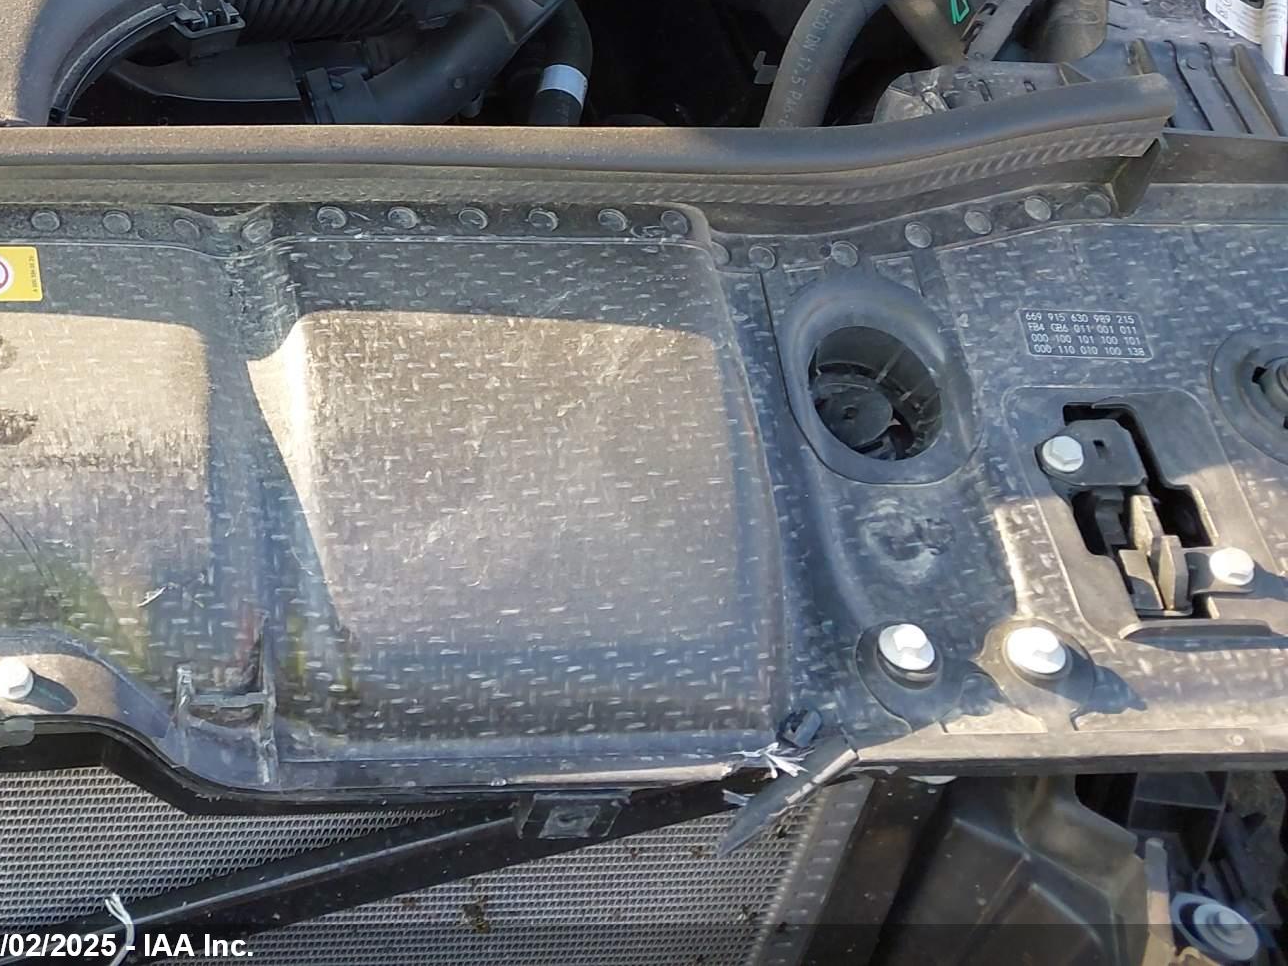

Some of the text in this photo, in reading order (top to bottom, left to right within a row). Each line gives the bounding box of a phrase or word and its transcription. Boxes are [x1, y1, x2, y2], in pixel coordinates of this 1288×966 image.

[811, 5, 834, 32] ECO
[801, 32, 821, 52] DN
[1026, 312, 1042, 321] 669
[1047, 313, 1066, 322] 915
[1070, 314, 1089, 322] 630
[1116, 315, 1135, 324] 215
[1073, 324, 1091, 333] 011
[1096, 325, 1114, 334] 001
[1119, 326, 1136, 334] 011
[1031, 333, 1141, 345] 000 100 101 100 101
[1033, 344, 1052, 354] 000
[1058, 345, 1076, 355] 110
[1080, 346, 1098, 355] 010
[1104, 346, 1122, 356] 100
